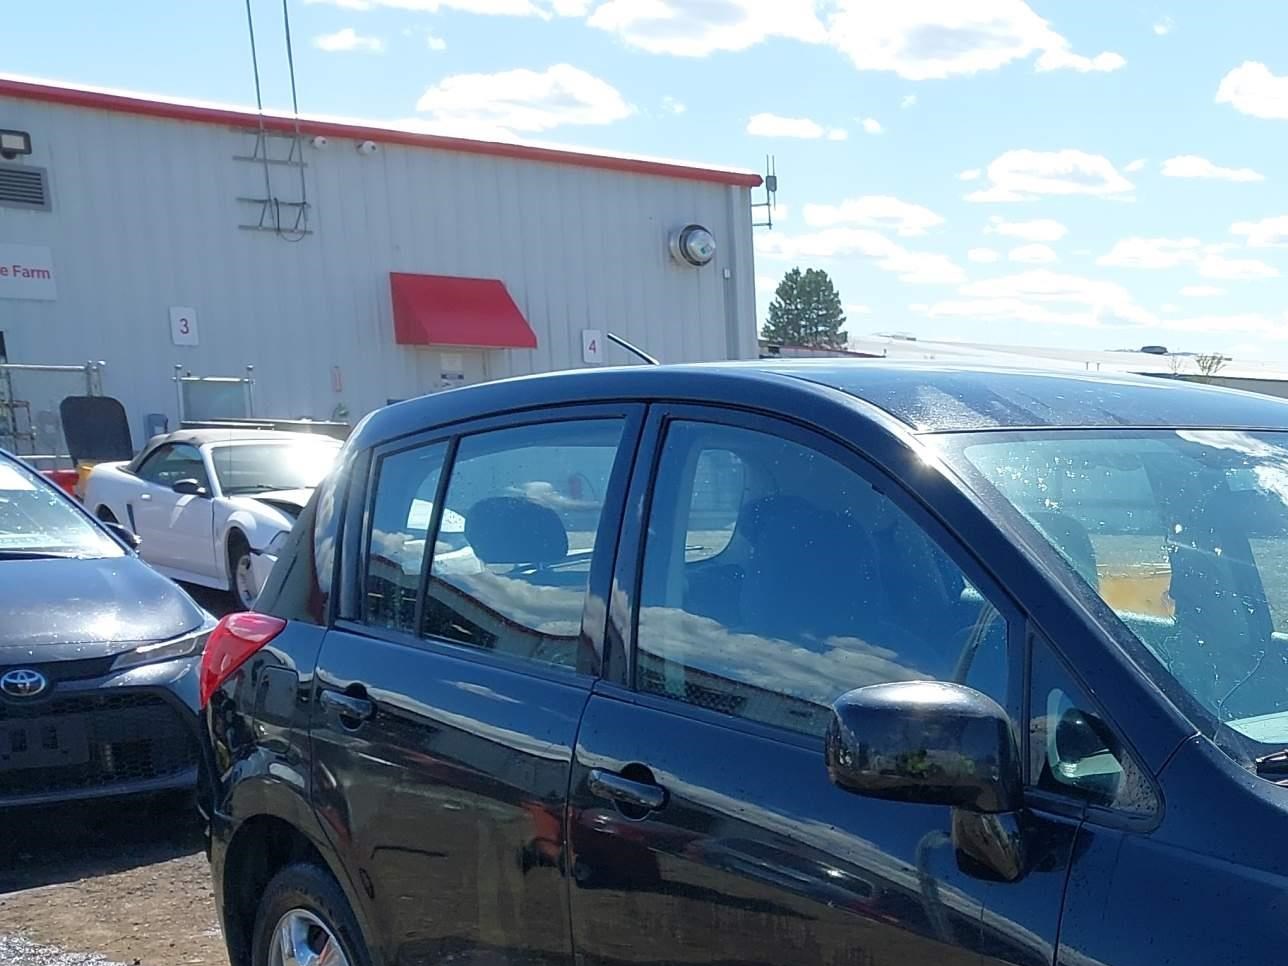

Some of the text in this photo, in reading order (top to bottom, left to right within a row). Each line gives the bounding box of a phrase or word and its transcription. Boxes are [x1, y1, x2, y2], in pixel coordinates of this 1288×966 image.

[12, 264, 51, 279] Farm
[179, 317, 190, 335] 3
[588, 339, 596, 353] 4
